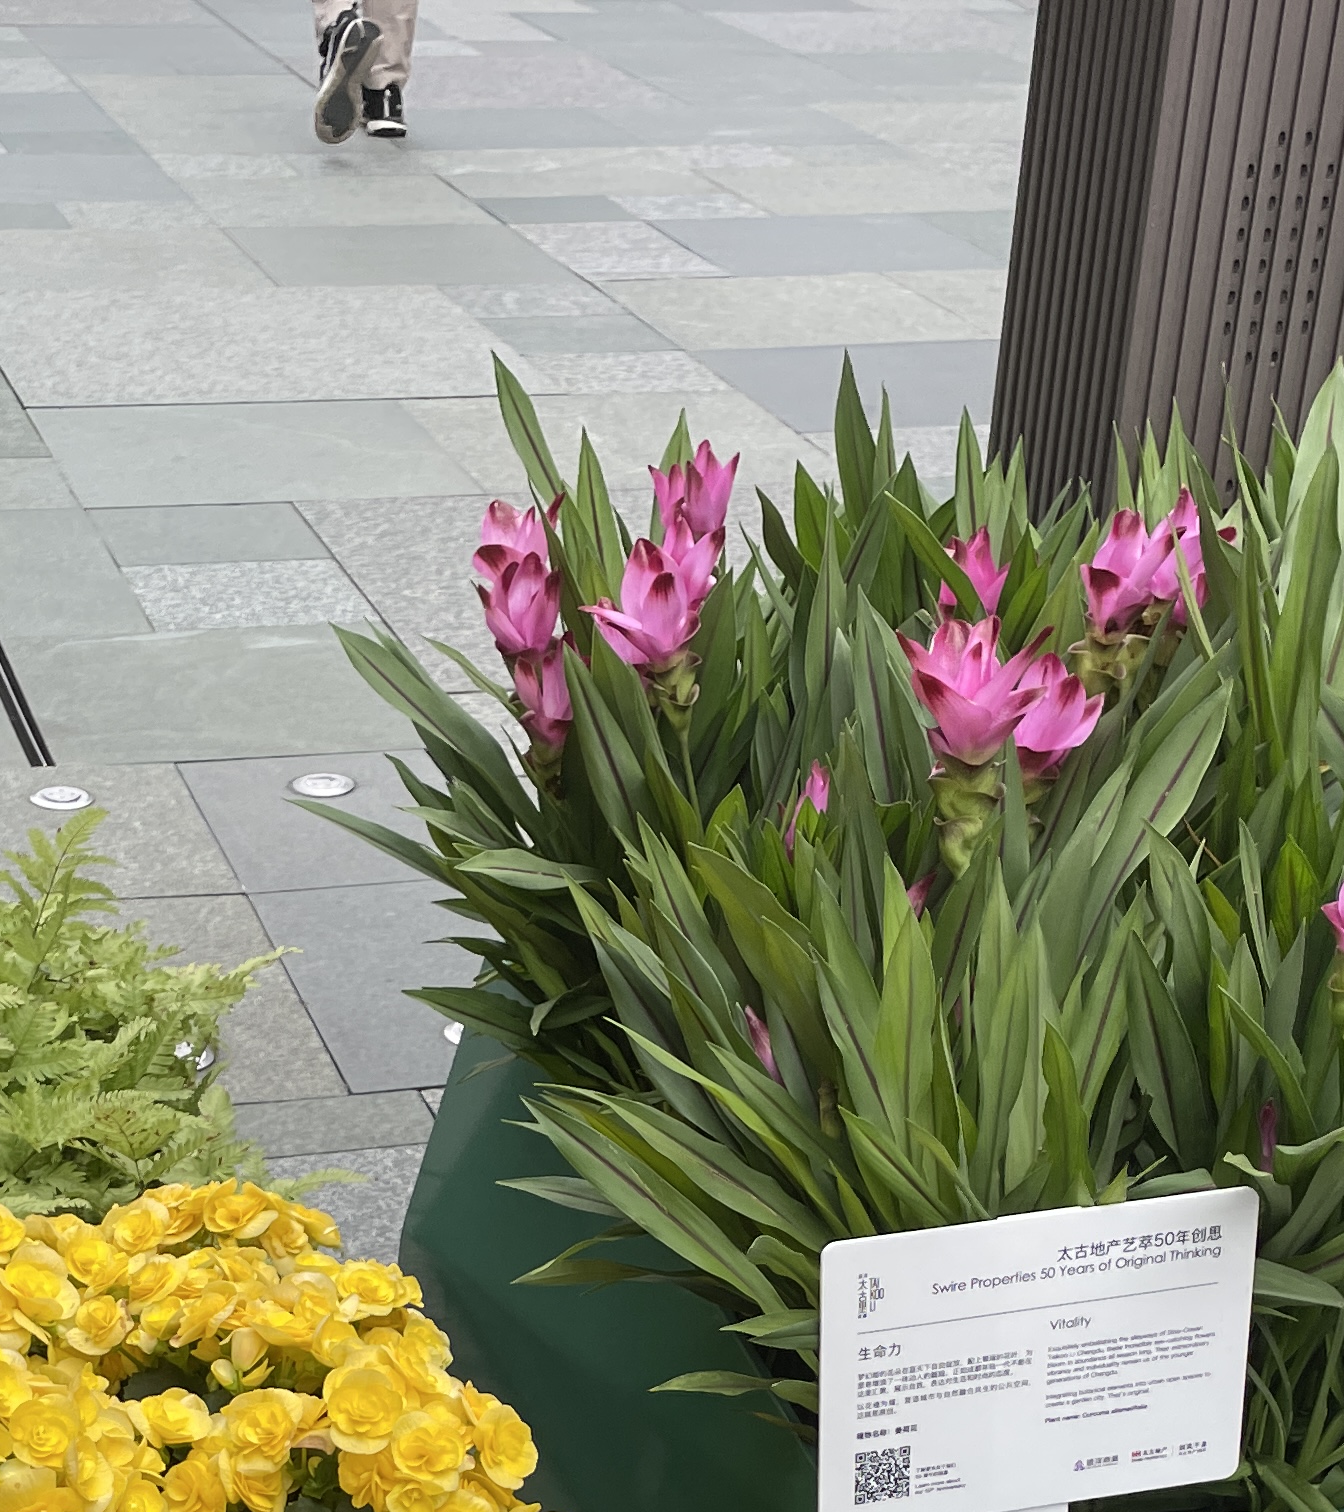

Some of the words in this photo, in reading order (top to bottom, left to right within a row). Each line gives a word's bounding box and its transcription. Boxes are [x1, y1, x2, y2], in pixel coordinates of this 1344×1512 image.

[1057, 1225, 1222, 1262] 太古地产艺萃50年创思
[932, 1282, 967, 1295] Swire
[971, 1272, 1036, 1289] Properties
[1040, 1267, 1056, 1279] 50
[1059, 1264, 1095, 1276] Years
[1098, 1258, 1112, 1271] of
[1115, 1251, 1166, 1269] Original
[1170, 1246, 1221, 1261] Thinking
[1050, 1316, 1091, 1330] Vitality
[858, 1343, 901, 1361] 生命力
